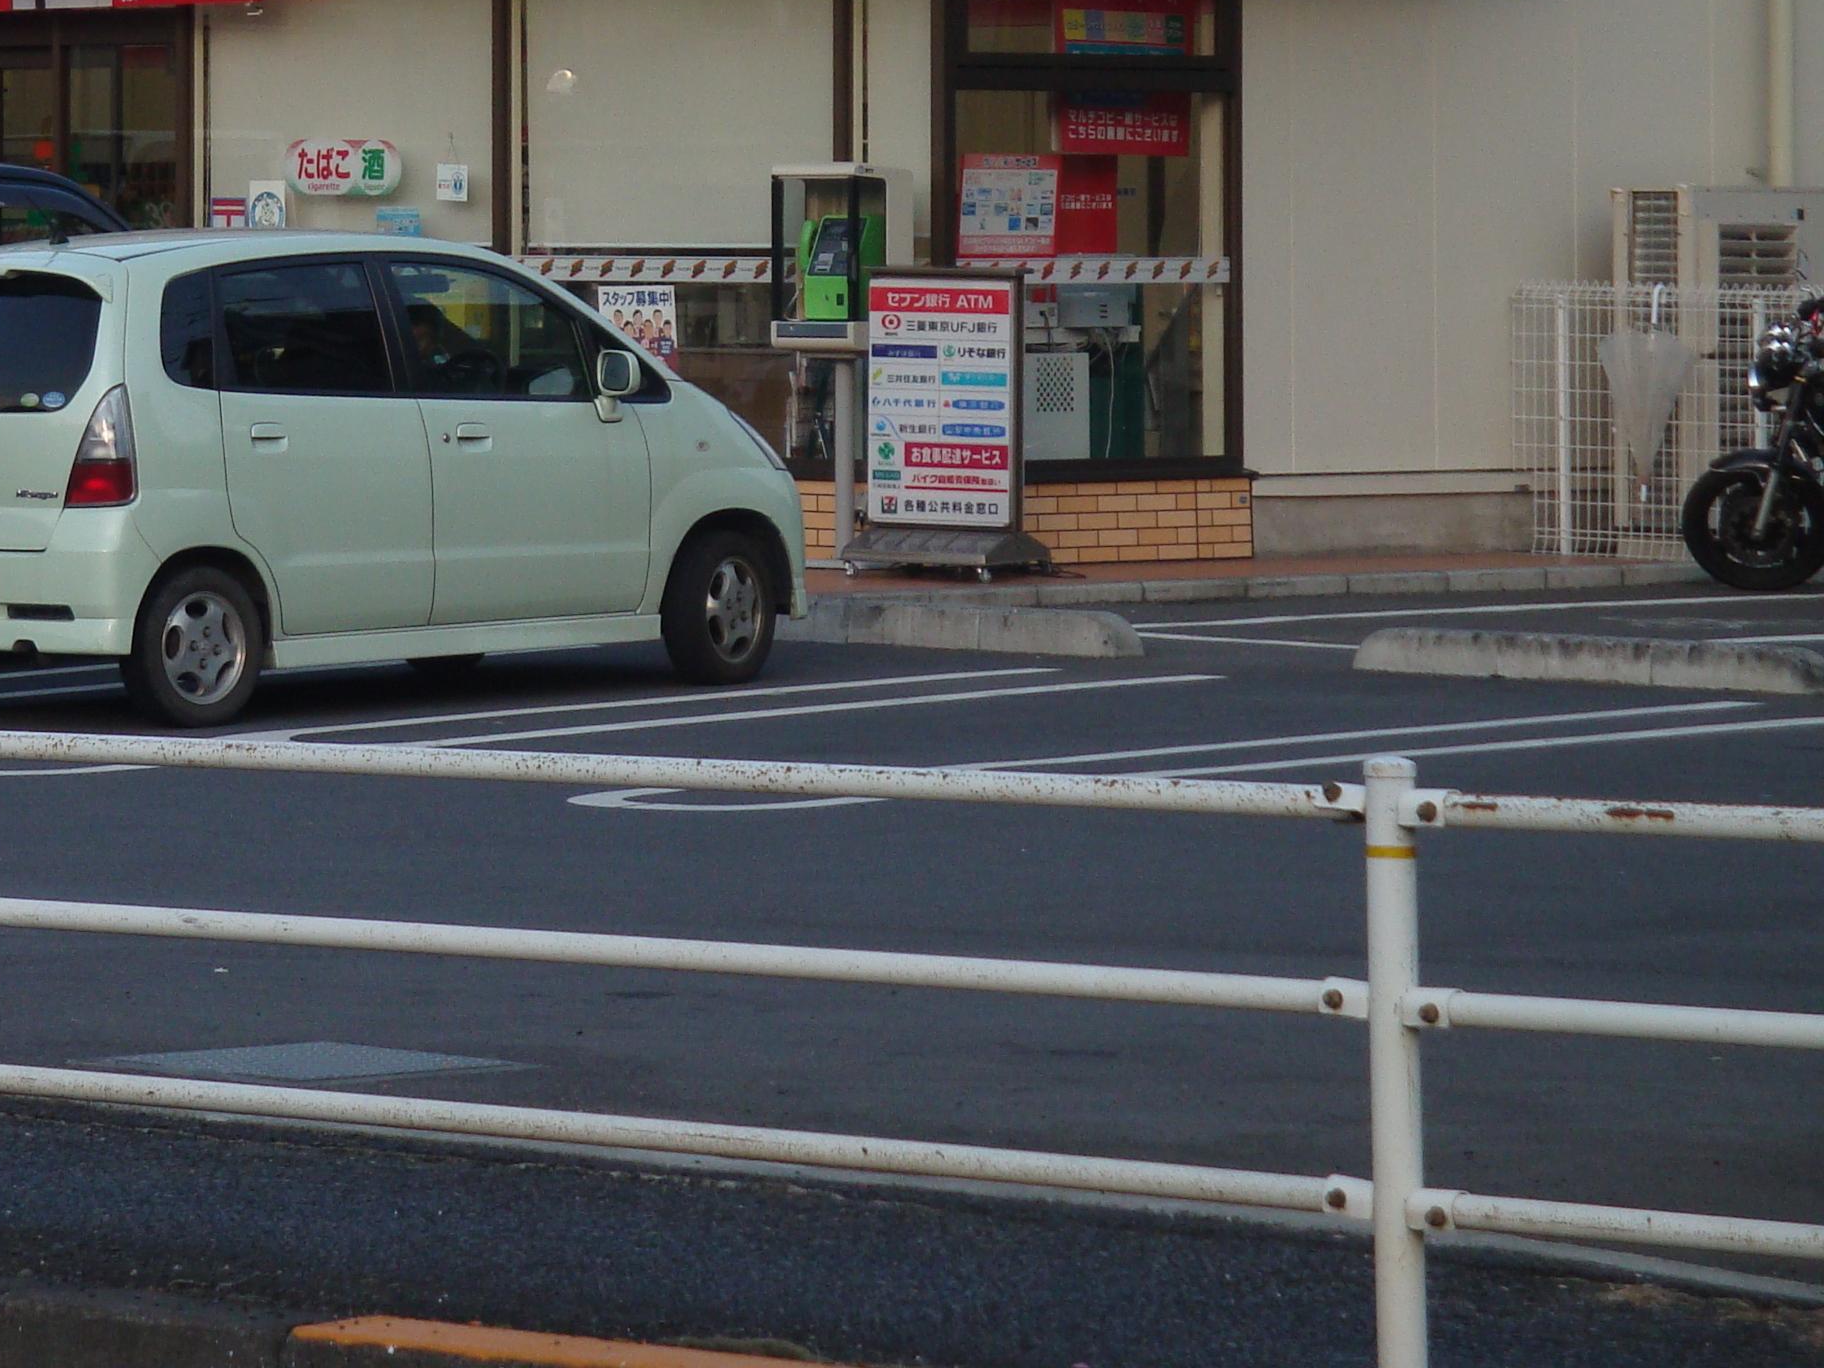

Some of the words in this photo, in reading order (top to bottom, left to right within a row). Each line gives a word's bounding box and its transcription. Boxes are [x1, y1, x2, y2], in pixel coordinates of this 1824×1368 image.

[297, 147, 351, 181] たばこ
[361, 148, 386, 181] 酒
[602, 289, 673, 307] スタッフ募集中!
[887, 292, 951, 308] セブン銀行
[956, 294, 994, 309] ATM
[906, 319, 998, 334] 三菱東京UFJ銀行
[957, 347, 1007, 359] りそな銀行
[887, 374, 937, 384] 三井住友銀行
[882, 397, 937, 409] 八千代銀行
[899, 423, 937, 435] 新生銀行
[911, 447, 1002, 465] お食事配達サービス
[904, 499, 999, 516] 各種公共料金窓口
